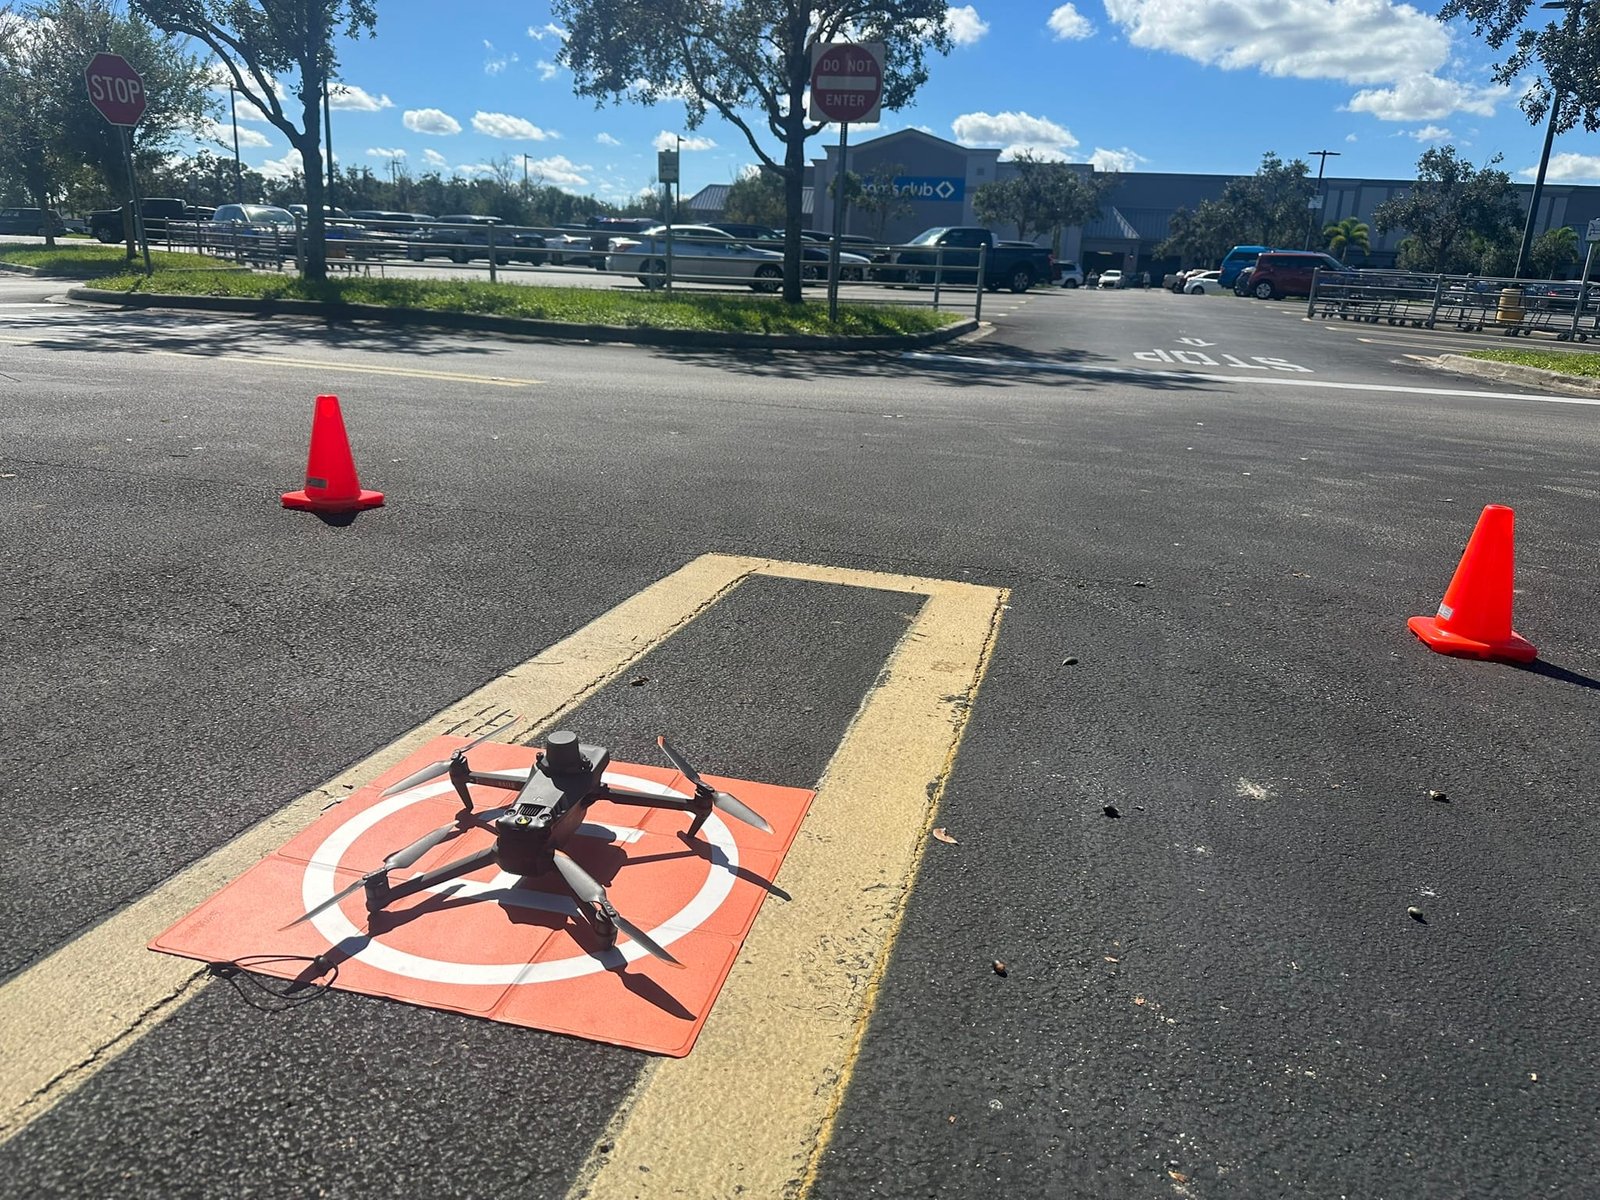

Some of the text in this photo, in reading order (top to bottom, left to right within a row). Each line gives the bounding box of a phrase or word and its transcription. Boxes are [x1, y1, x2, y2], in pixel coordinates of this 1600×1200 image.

[823, 59, 872, 73] DO NOT
[90, 74, 140, 105] STOP
[826, 94, 866, 107] ENTER
[861, 183, 899, 195] sas
[1132, 348, 1315, 374] STOP
